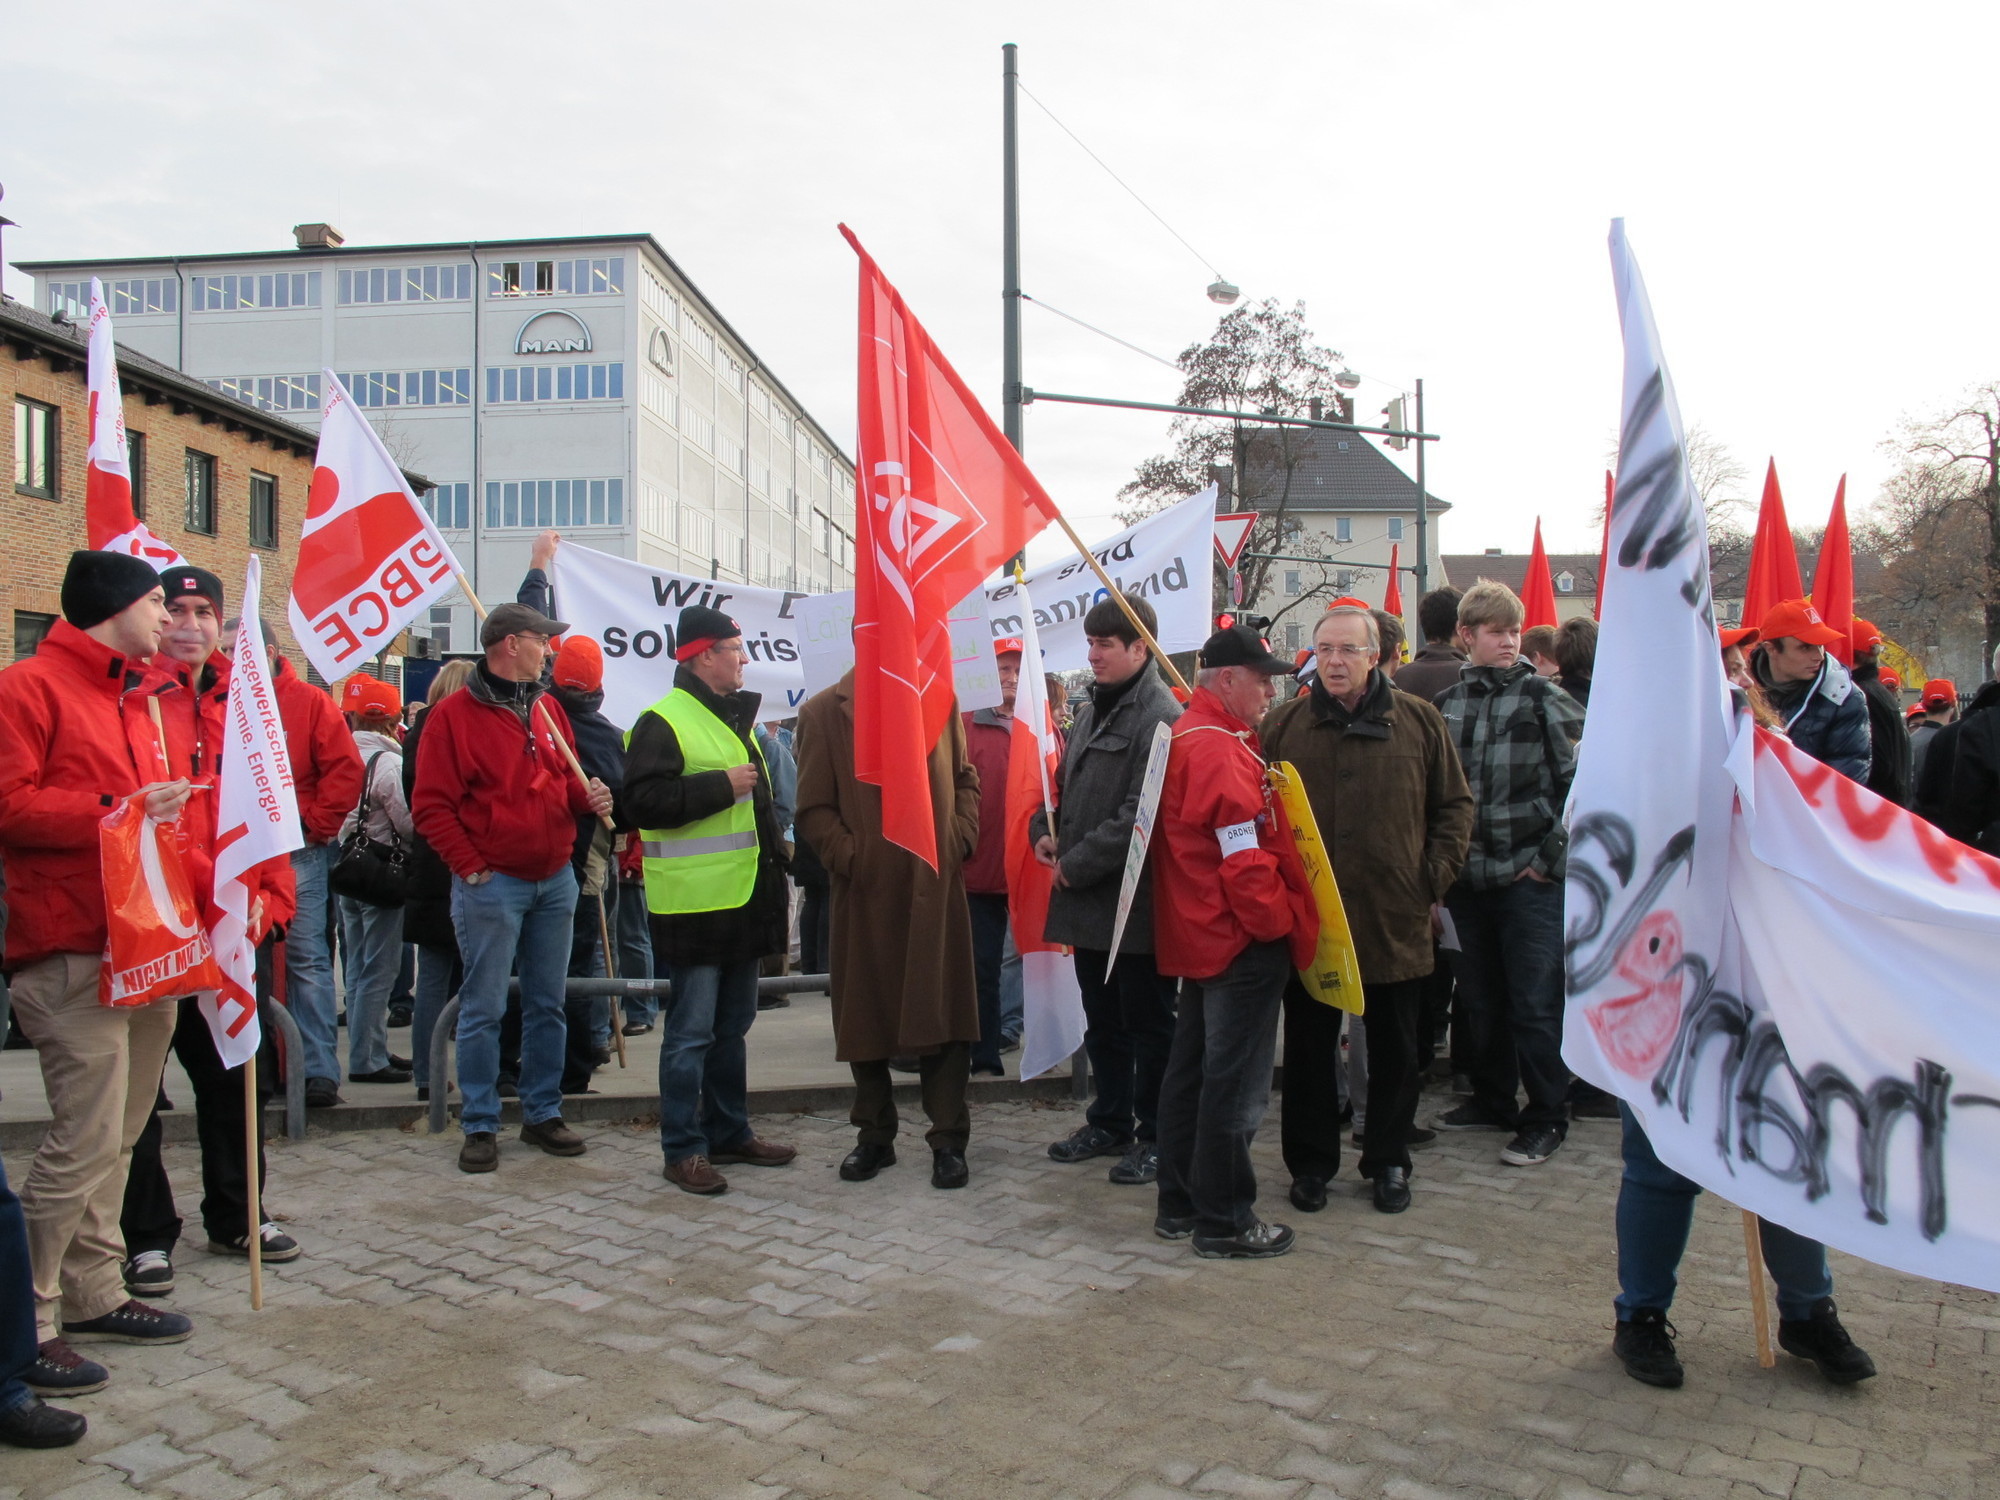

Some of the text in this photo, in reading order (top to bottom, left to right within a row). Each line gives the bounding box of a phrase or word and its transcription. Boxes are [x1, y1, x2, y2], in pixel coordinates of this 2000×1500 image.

[521, 339, 586, 354] MAN
[651, 576, 733, 610] Wir
[230, 676, 282, 823] Chemie, Energie
